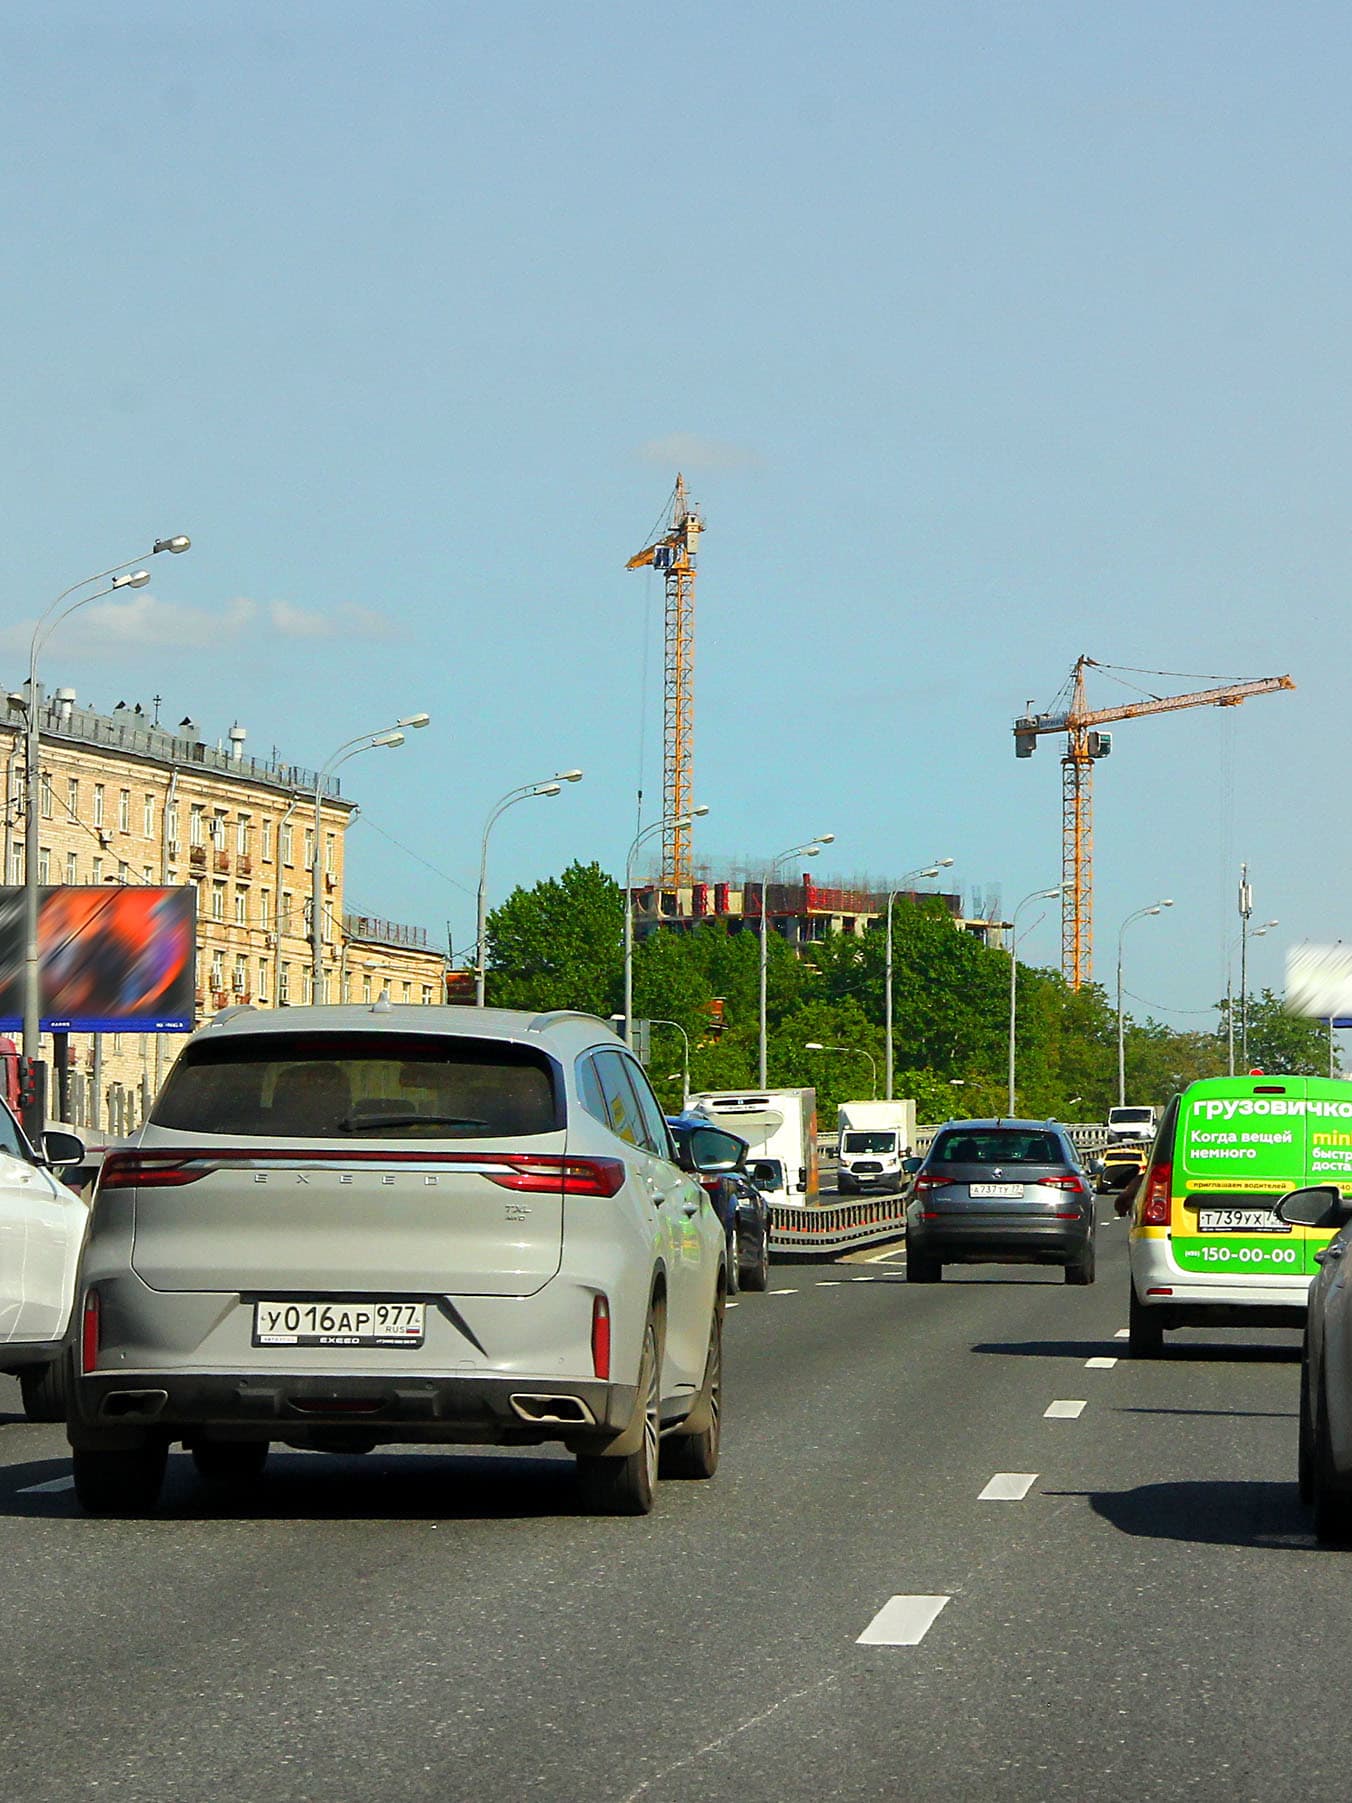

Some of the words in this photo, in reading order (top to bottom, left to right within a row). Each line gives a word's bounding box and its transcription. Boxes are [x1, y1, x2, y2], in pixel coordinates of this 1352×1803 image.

[1190, 1130, 1237, 1144] Когда
[1241, 1130, 1292, 1144] вещей
[1190, 1148, 1256, 1159] немного
[254, 1173, 440, 1186] EXEED
[1243, 1182, 1287, 1190] водителей
[1205, 1210, 1262, 1225] Т739УХ
[1201, 1247, 1296, 1262] 150-00-00
[267, 1306, 371, 1332] У016АР
[377, 1306, 417, 1326] 977
[385, 1325, 405, 1333] RUS
